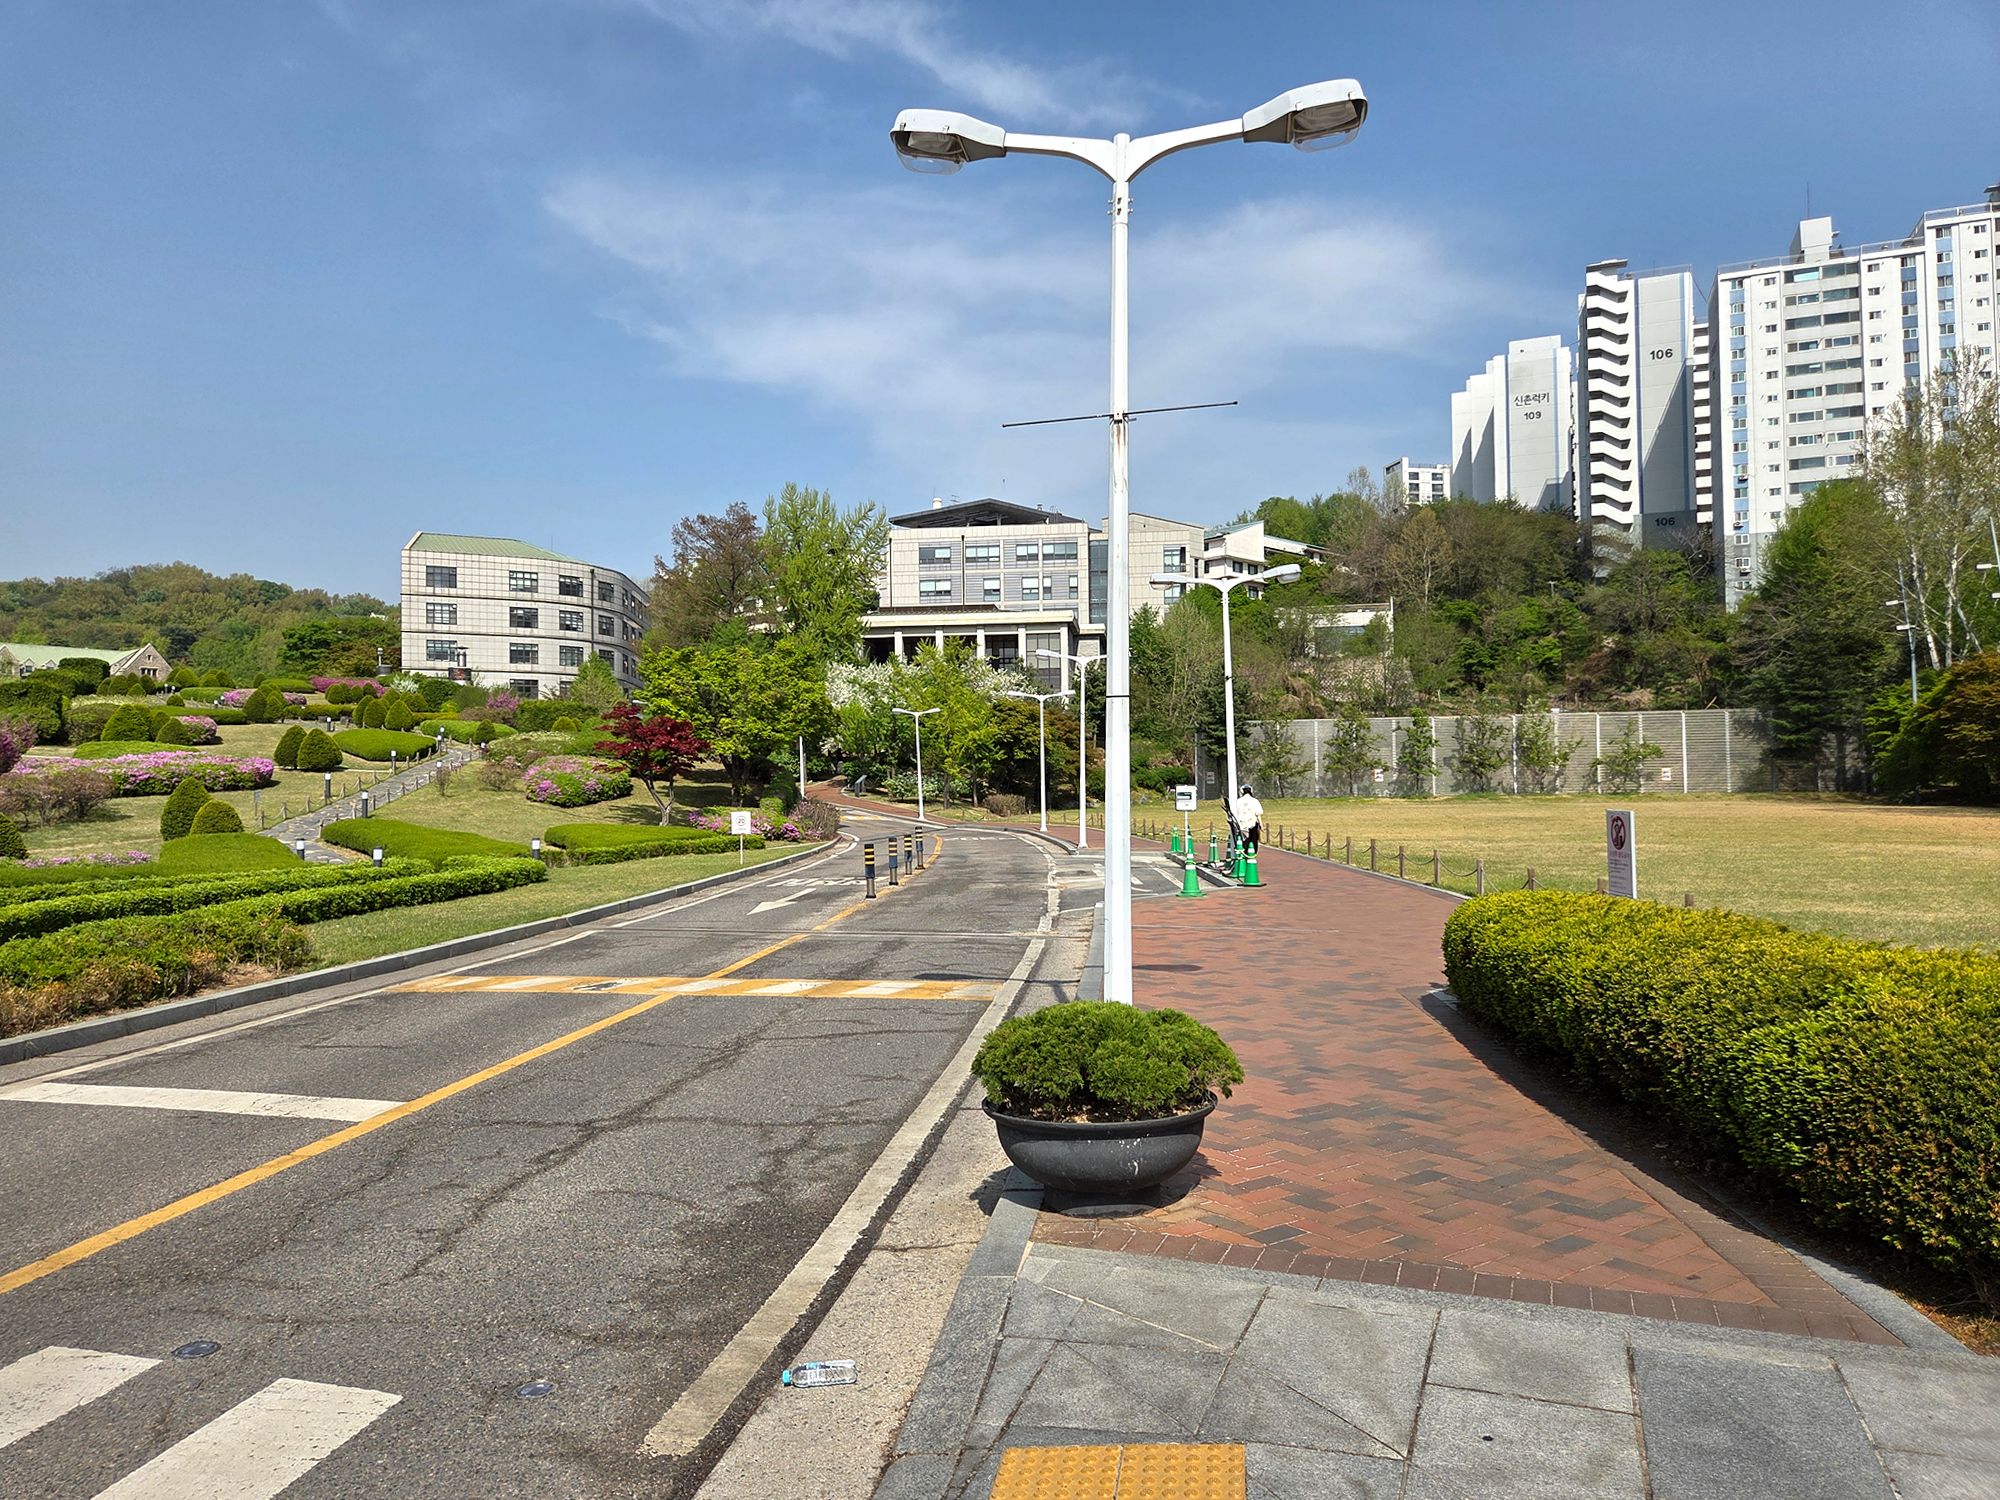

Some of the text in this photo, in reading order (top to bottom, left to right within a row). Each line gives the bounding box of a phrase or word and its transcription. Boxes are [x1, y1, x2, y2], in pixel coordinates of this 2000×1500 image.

[1649, 348, 1673, 360] 106
[1513, 392, 1550, 407] 신촌럭키
[1523, 410, 1542, 420] 109
[1655, 516, 1676, 526] 106
